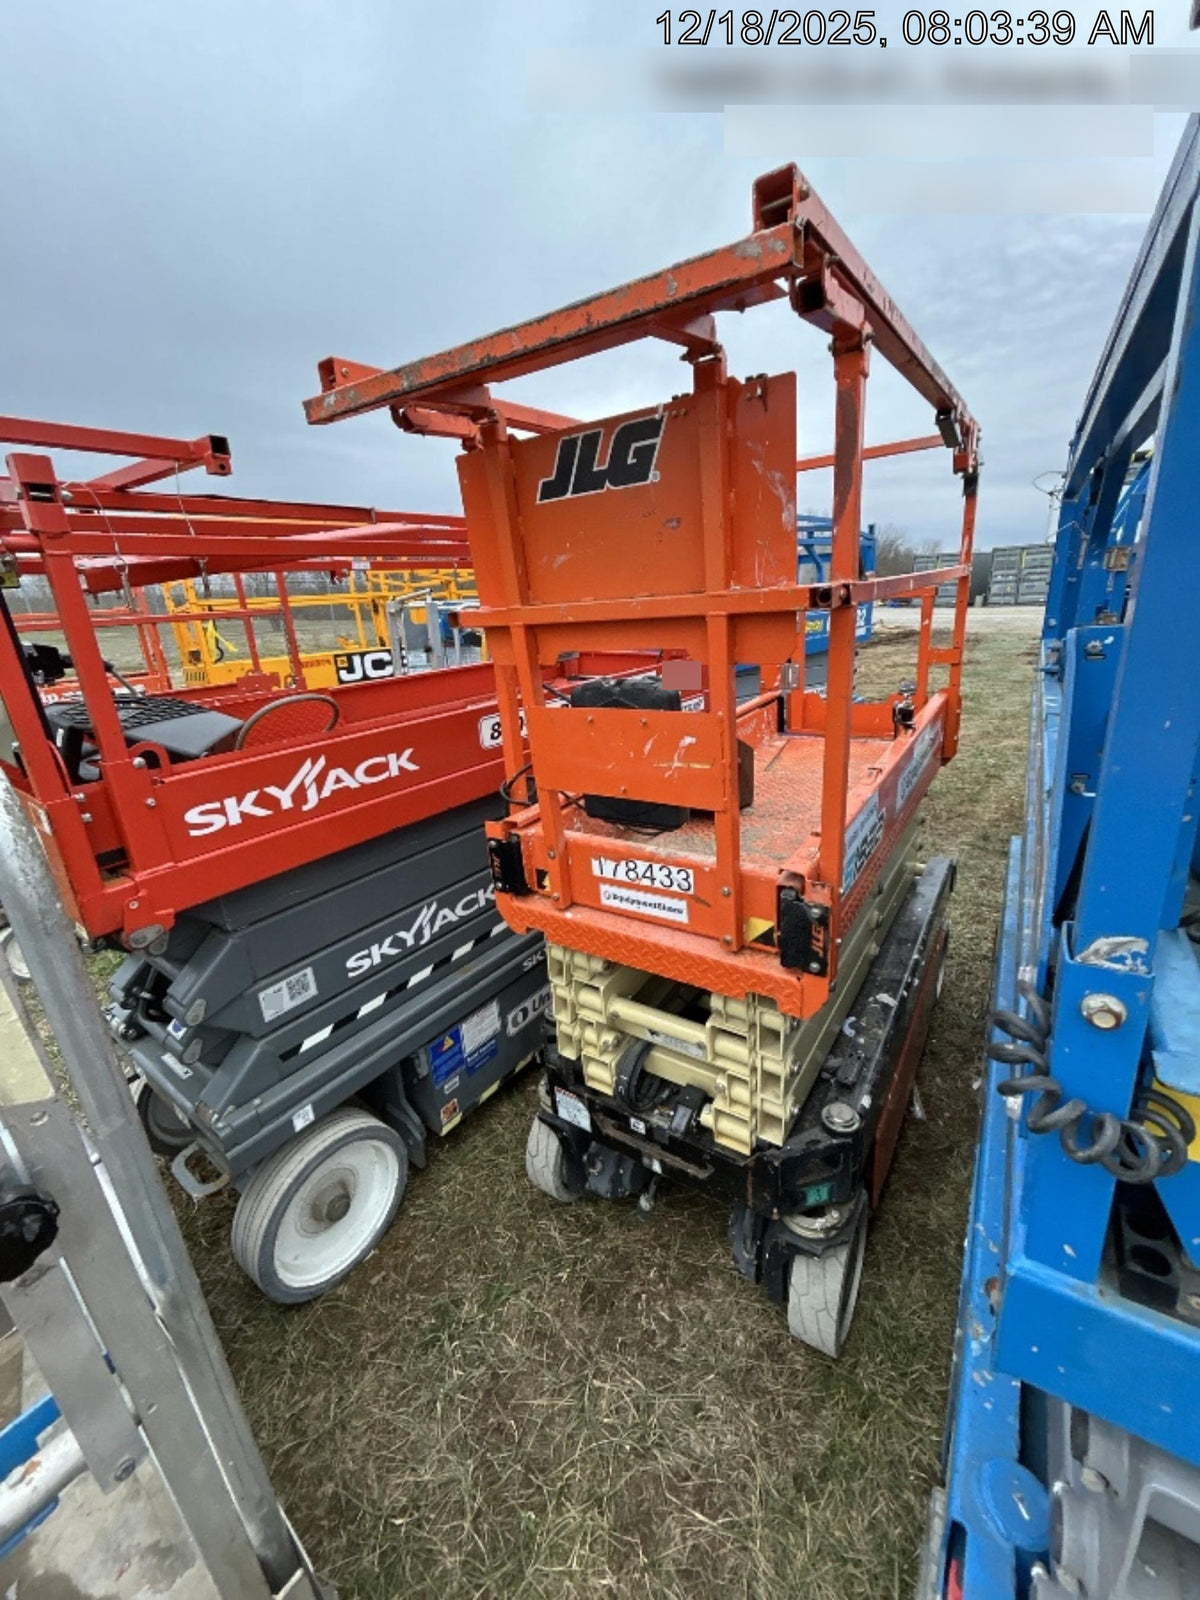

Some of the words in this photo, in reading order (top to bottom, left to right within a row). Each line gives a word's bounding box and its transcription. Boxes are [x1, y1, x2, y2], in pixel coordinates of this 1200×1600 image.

[536, 411, 667, 504] JLG
[338, 651, 408, 682] JC
[184, 748, 420, 836] SKYJACK
[598, 858, 692, 893] 178433
[345, 883, 496, 979] SKYJACK
